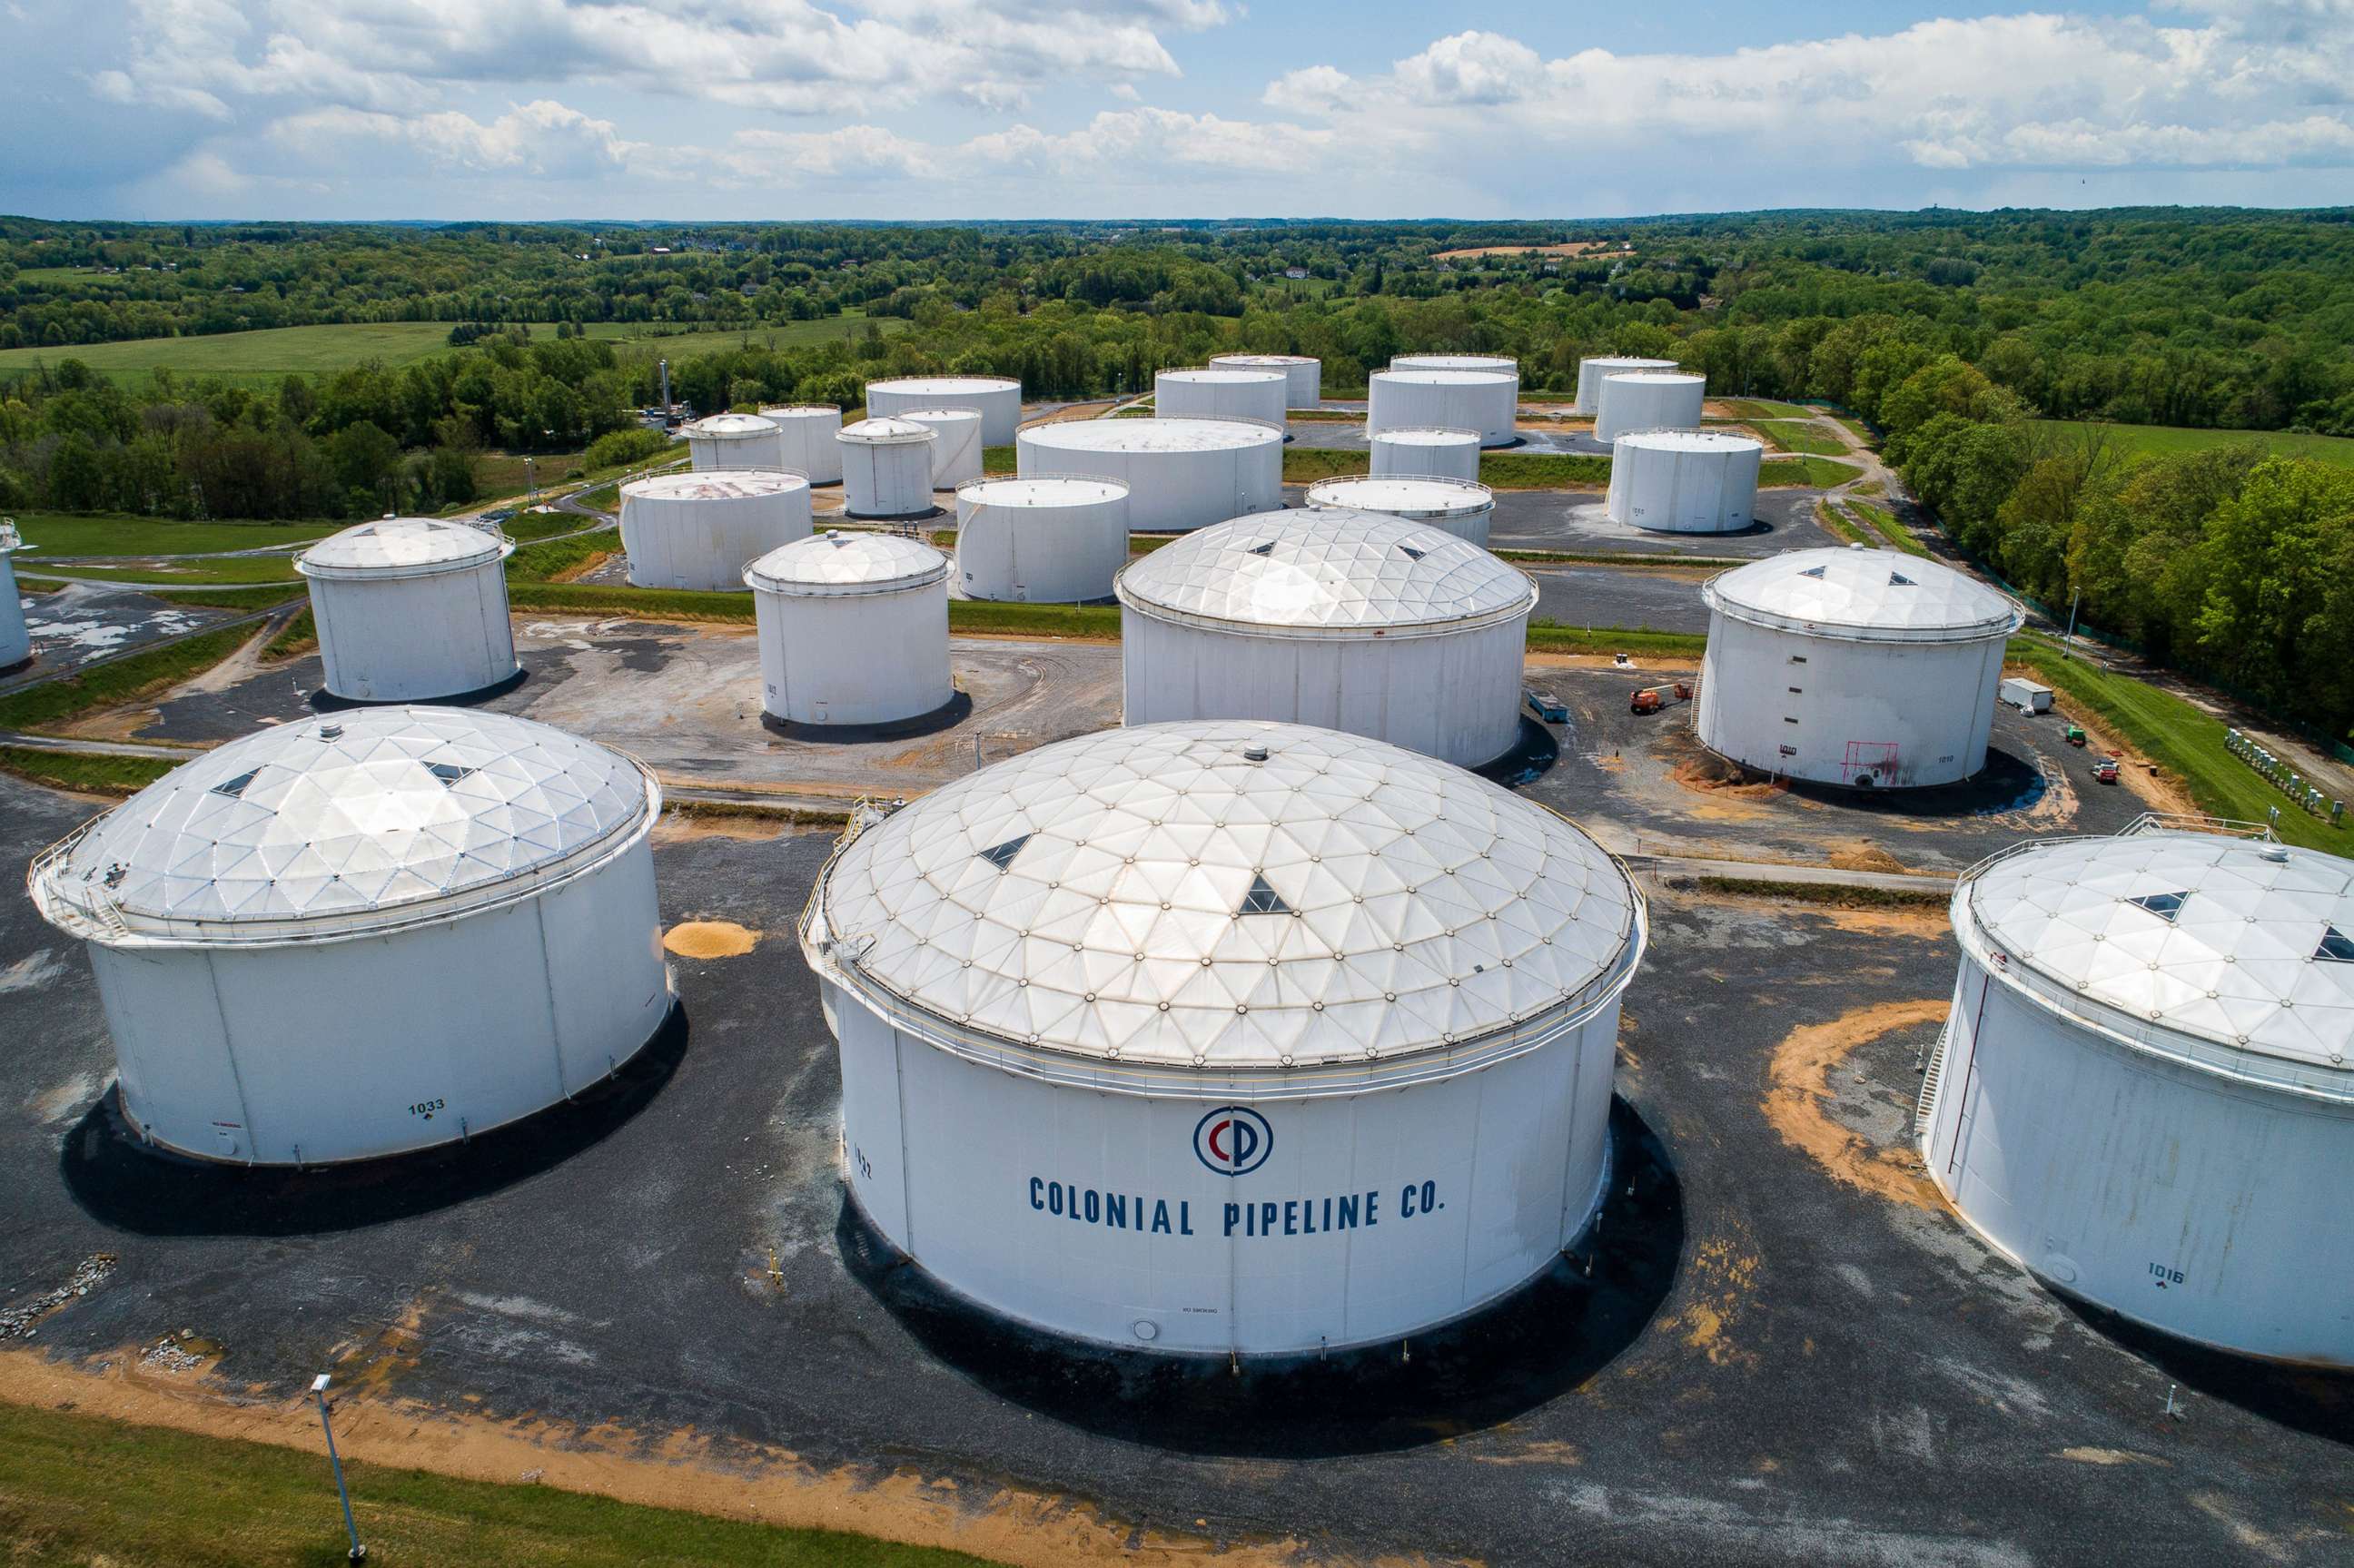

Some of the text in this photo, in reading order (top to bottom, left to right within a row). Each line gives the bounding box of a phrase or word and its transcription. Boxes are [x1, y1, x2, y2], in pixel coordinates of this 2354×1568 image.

[408, 1099, 444, 1115] 1033
[1209, 1119, 1258, 1167] CP
[1030, 1177, 1445, 1237] COLONIAL PIPELINE CO.
[2149, 1262, 2185, 1285] 1016
